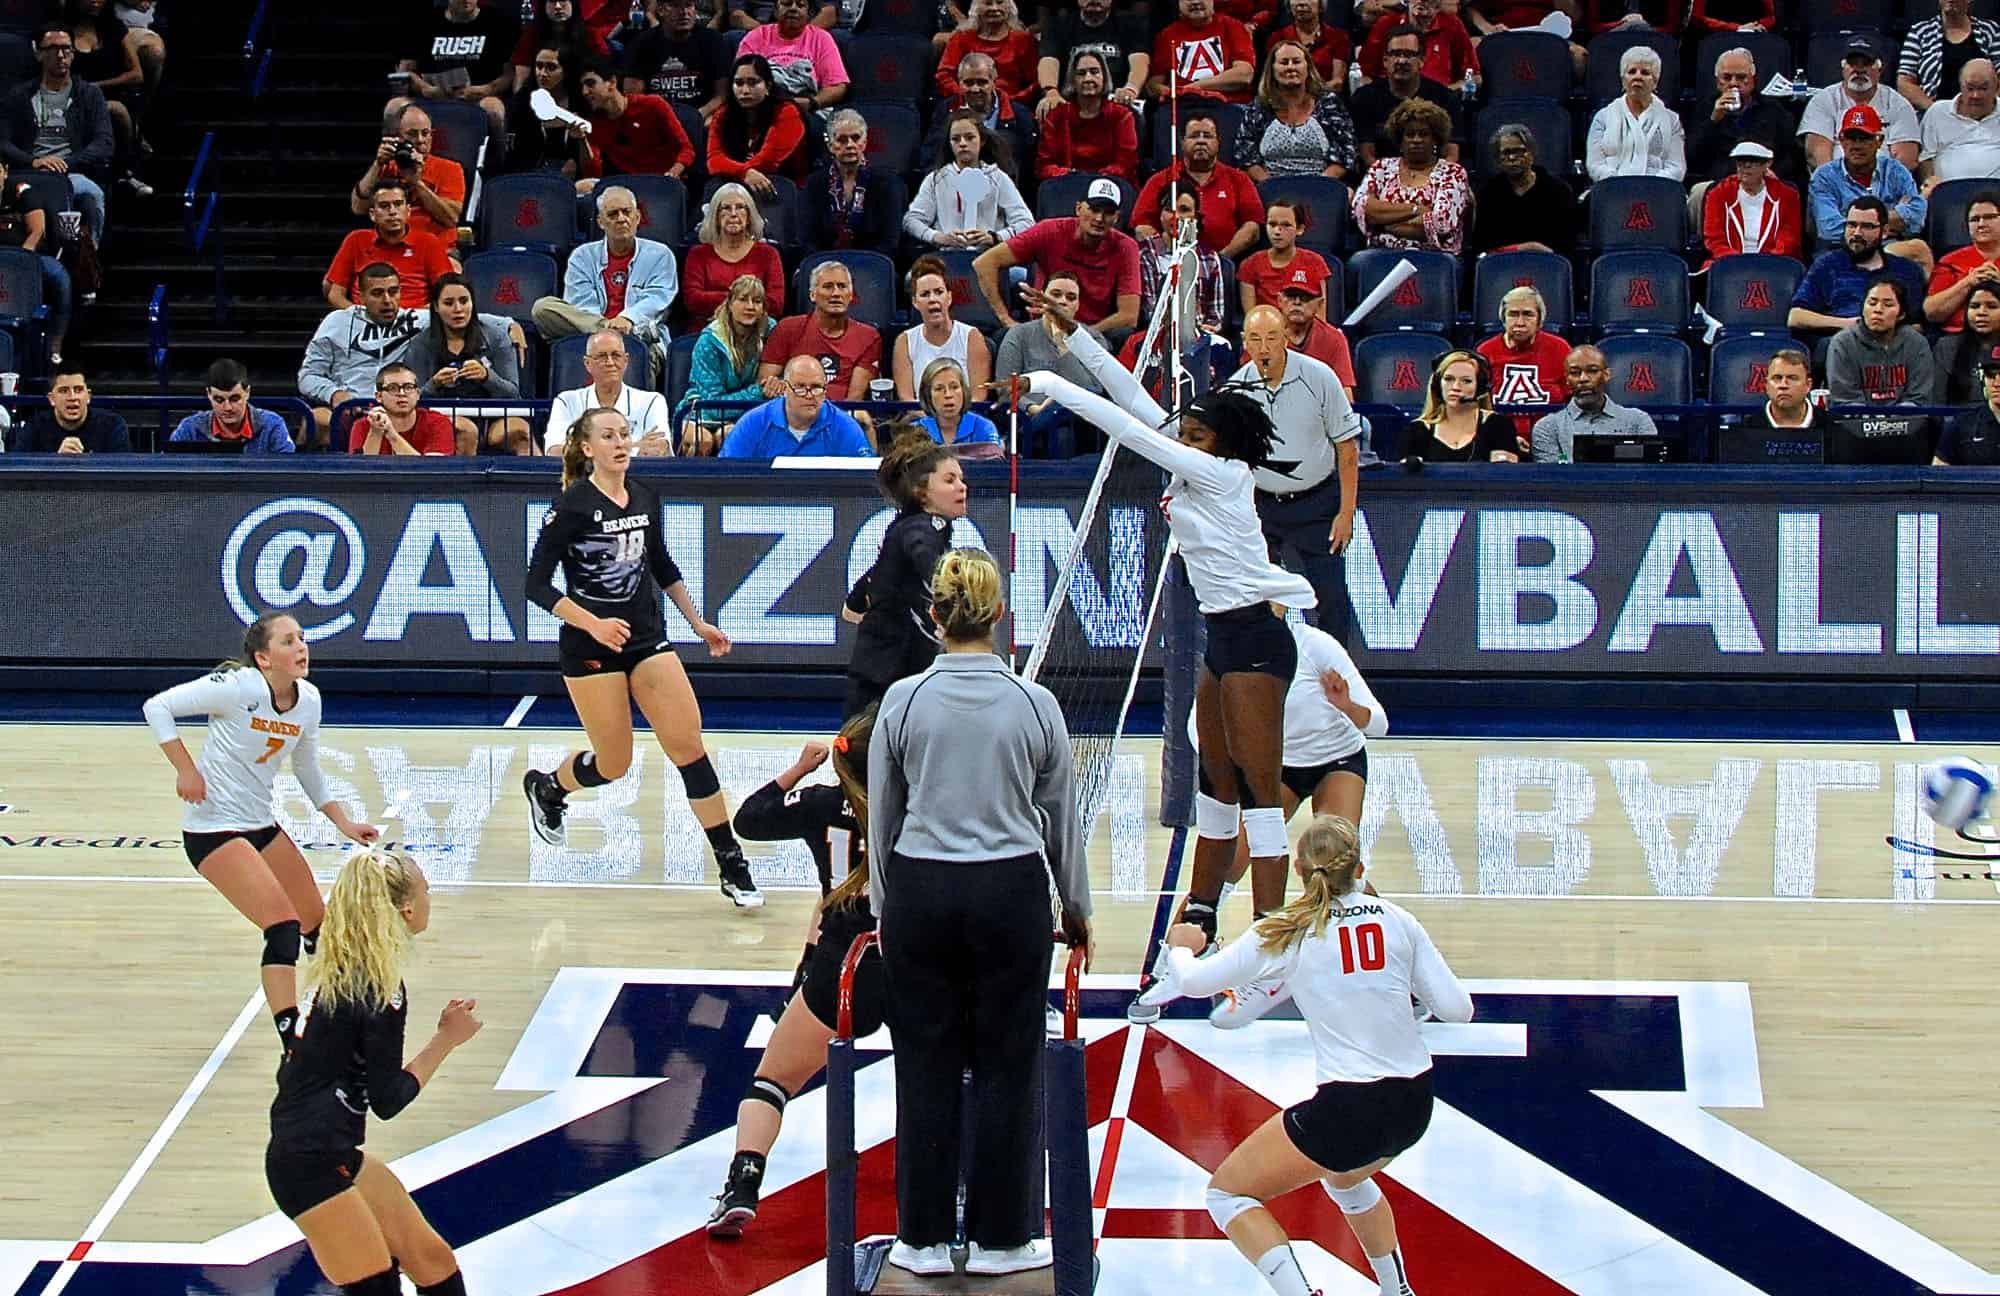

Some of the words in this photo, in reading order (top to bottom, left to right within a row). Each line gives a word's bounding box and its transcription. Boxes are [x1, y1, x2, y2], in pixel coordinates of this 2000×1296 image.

[432, 36, 486, 55] RUSH
[650, 76, 697, 90] SWEET
[1625, 202, 1655, 229] A
[1626, 278, 1656, 307] A
[1742, 279, 1772, 310] A
[1391, 360, 1422, 390] A
[1493, 364, 1550, 405] A
[1626, 362, 1657, 392] A
[602, 514, 650, 533] BEAVERS
[616, 529, 645, 562] 18
[250, 716, 301, 736] BEAVERS
[255, 736, 286, 764] 7
[0, 835, 182, 849] Medic
[1328, 904, 1385, 919] RIZONA
[1338, 922, 1386, 975] 10
